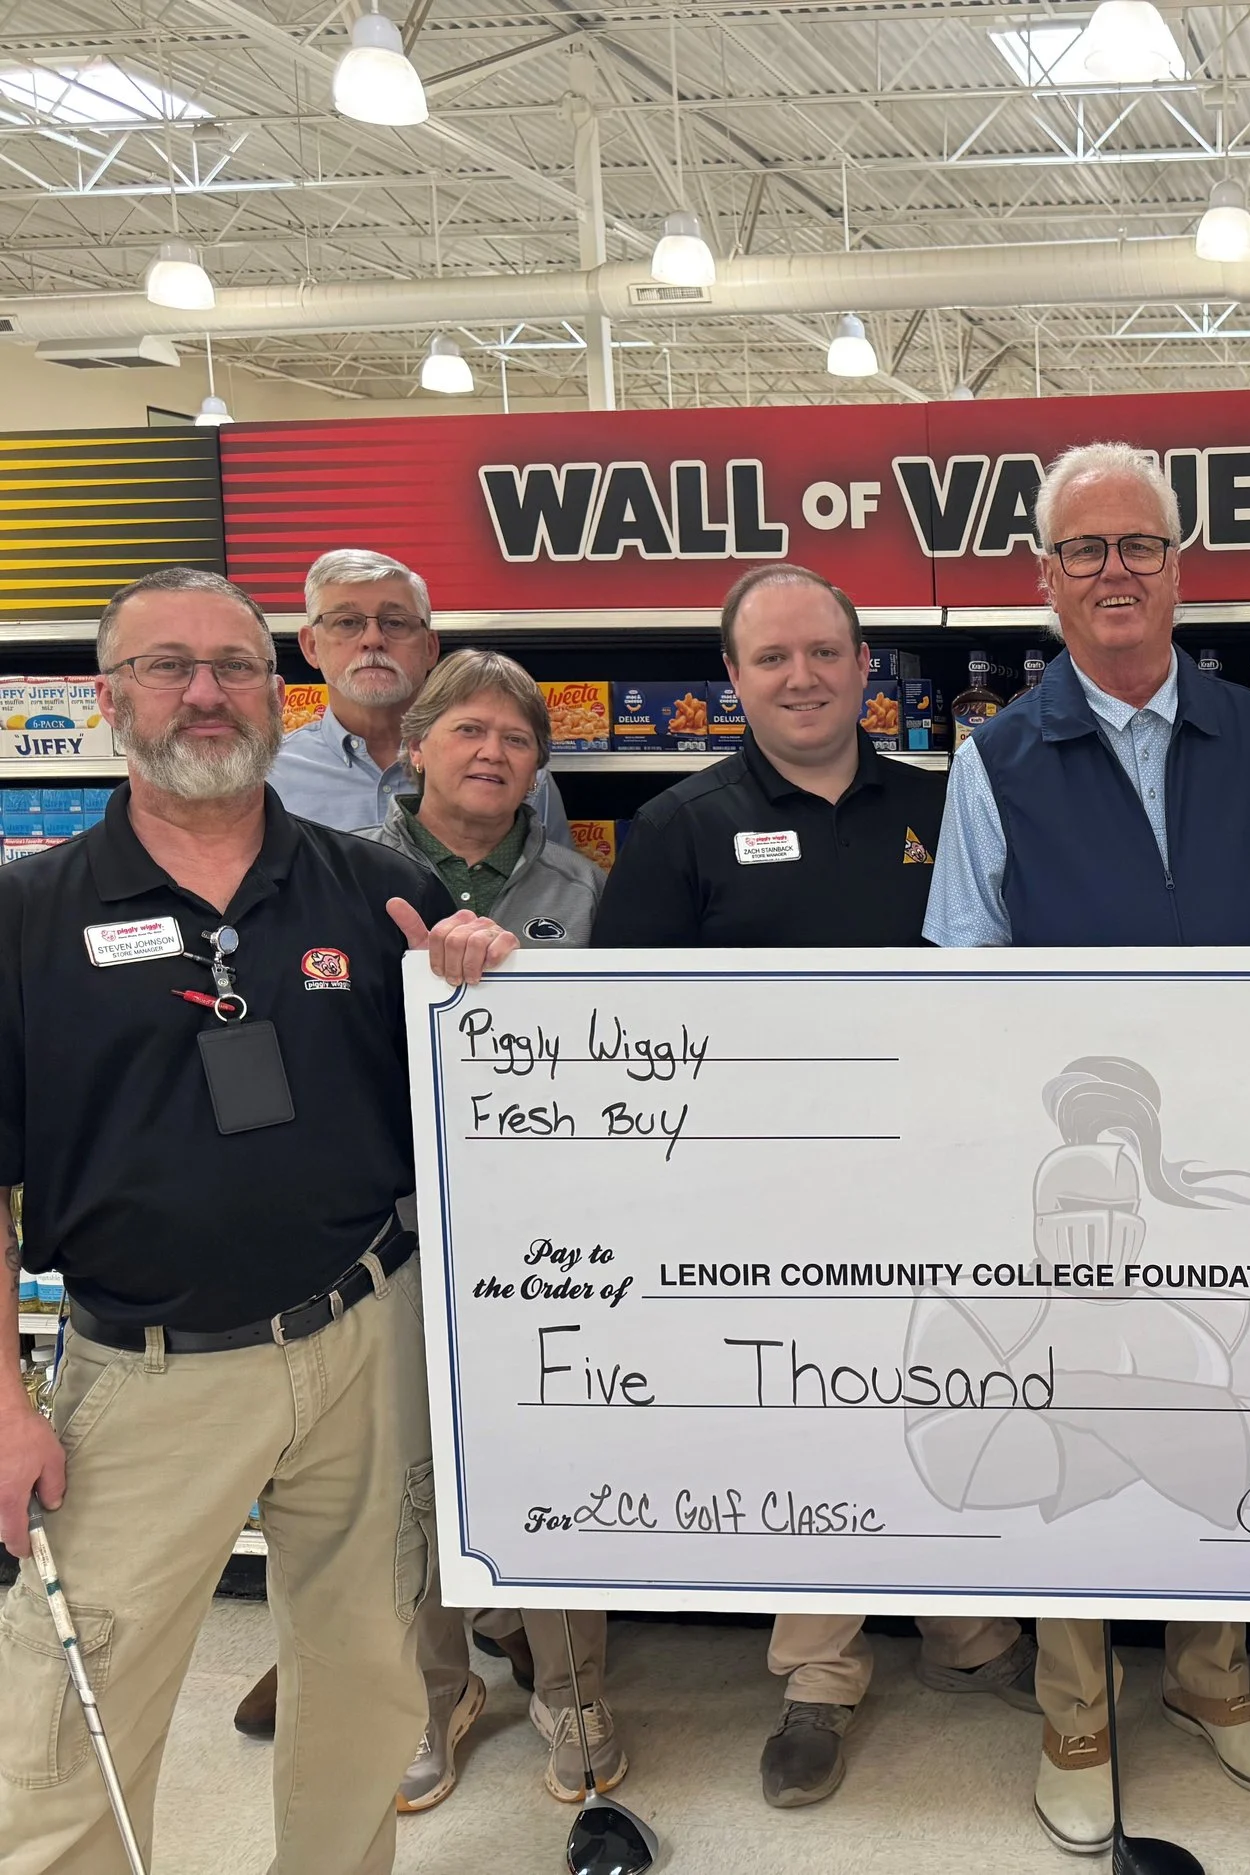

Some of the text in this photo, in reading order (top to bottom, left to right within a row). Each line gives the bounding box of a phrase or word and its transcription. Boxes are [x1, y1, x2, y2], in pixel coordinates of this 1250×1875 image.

[479, 457, 789, 562] WALL
[801, 480, 881, 531] OF
[29, 687, 65, 699] JIFFY
[70, 686, 97, 699] JIFF
[32, 720, 66, 729] 6-PACK
[116, 926, 138, 935] piggly
[98, 936, 175, 954] STEVEN JOHNSON
[112, 946, 164, 958] STORE MANAGER
[459, 1008, 709, 1081] Piggly Wiggly
[471, 1093, 575, 1137] Fresh
[523, 1238, 615, 1272] Pay to
[660, 1263, 772, 1287] LENOIR
[780, 1263, 963, 1288] COMMUNITY
[972, 1263, 1114, 1289] COLLEGE
[472, 1274, 634, 1308] the Order of
[538, 1324, 1055, 1410] Five Thousand
[524, 1506, 574, 1533] For
[574, 1484, 657, 1529] LCC
[676, 1489, 746, 1534] Golf
